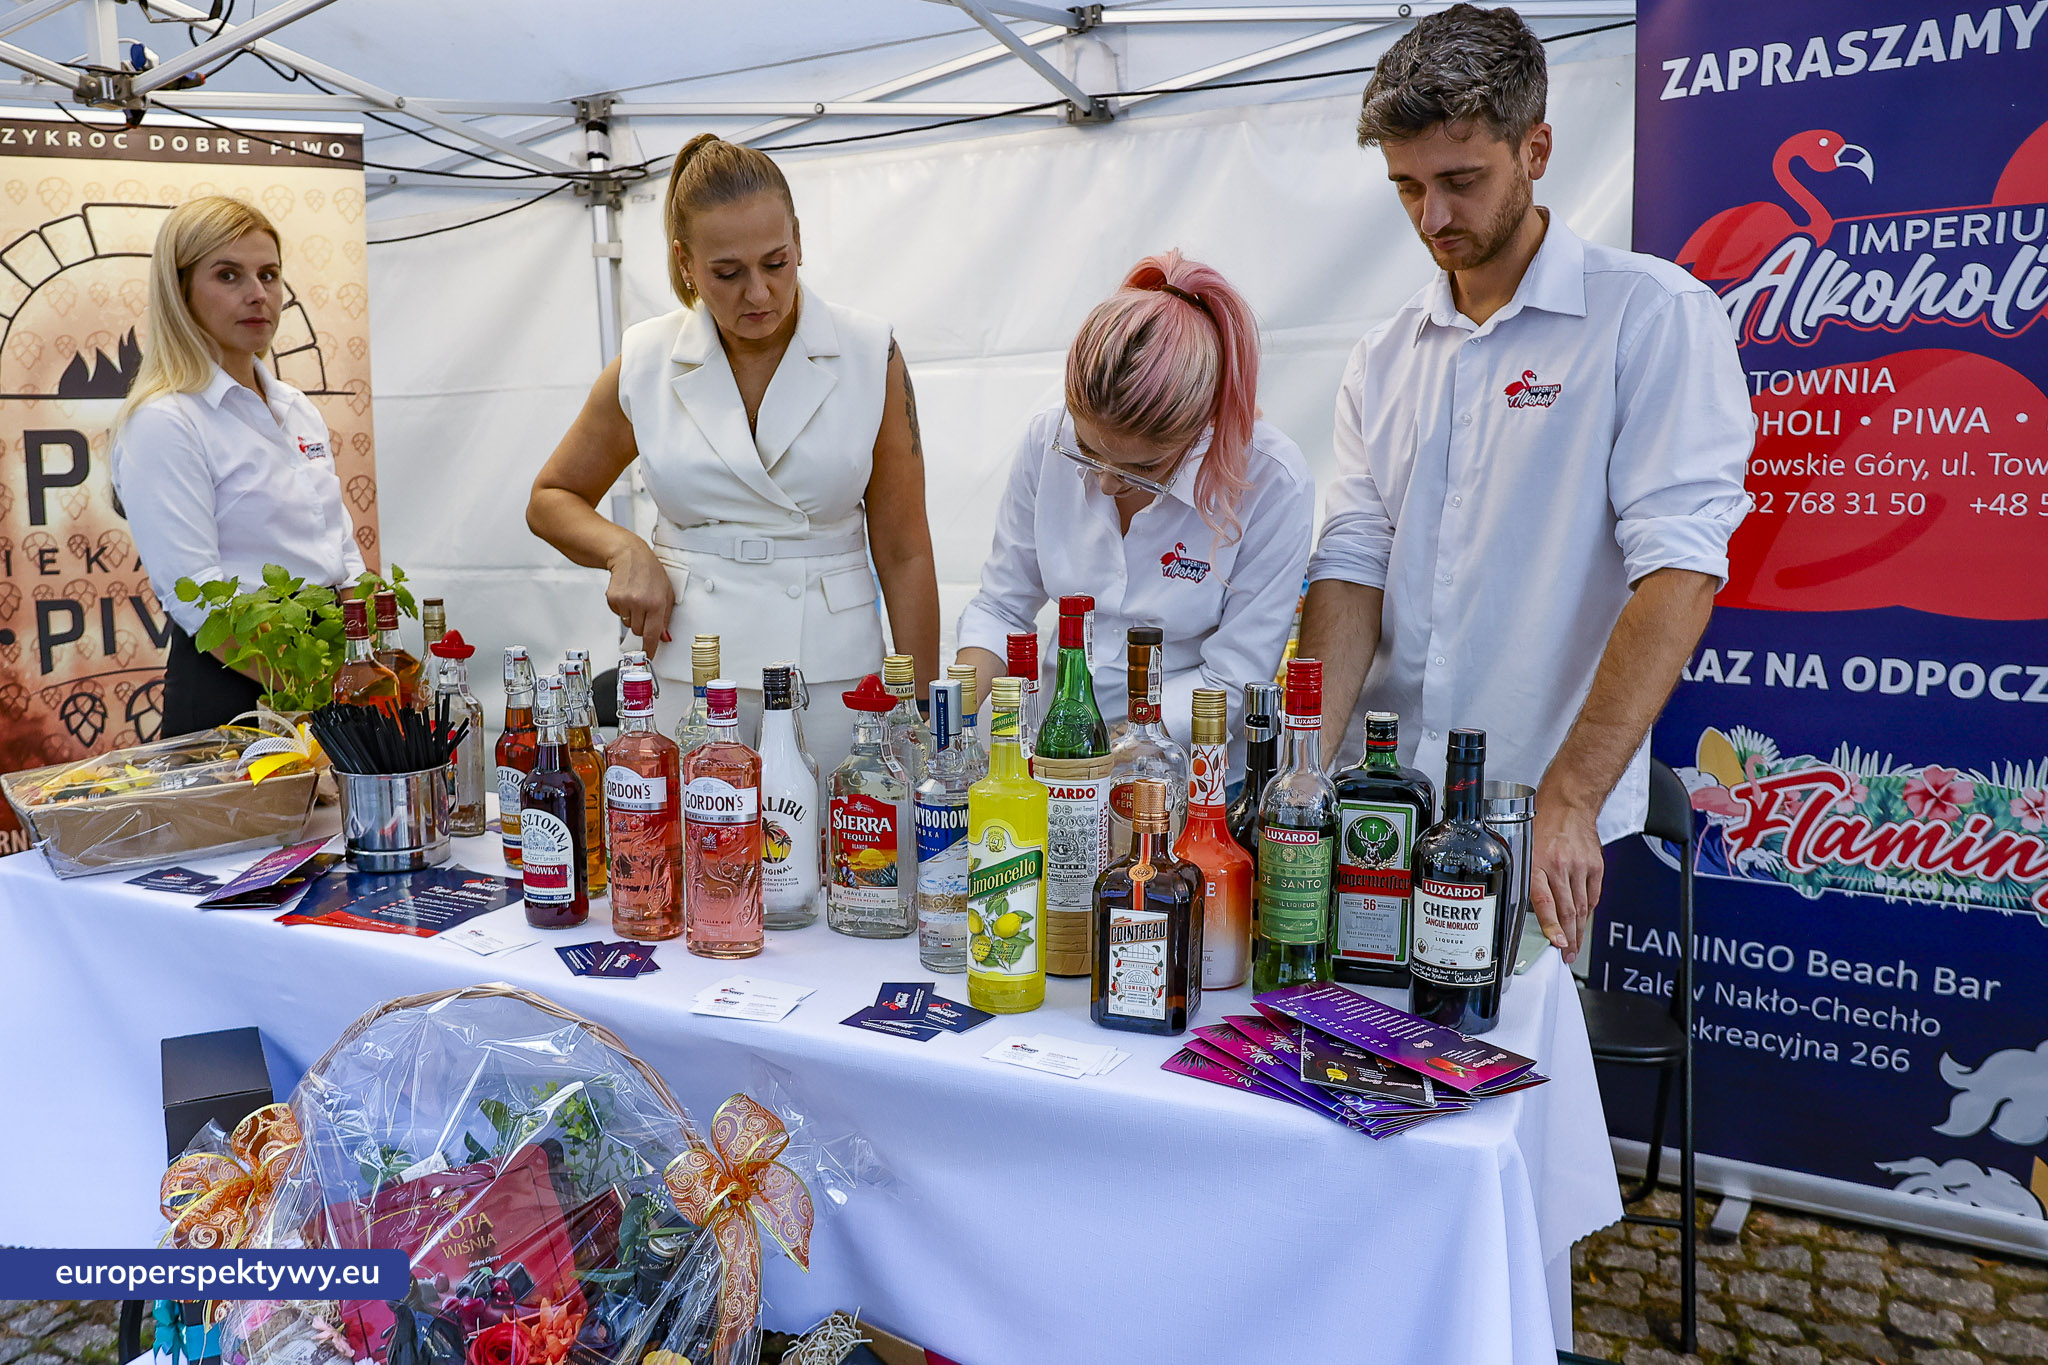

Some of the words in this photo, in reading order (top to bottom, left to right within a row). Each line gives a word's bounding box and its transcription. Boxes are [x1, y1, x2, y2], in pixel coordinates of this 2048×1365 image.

[1660, 1, 2048, 100] ZAPRASZAMY
[149, 135, 250, 154] DOBRE
[270, 139, 345, 158] PIWO
[1848, 208, 2048, 256] IMPERIU
[1752, 410, 1840, 436] HOLI
[1892, 406, 1991, 435] PIWA
[1854, 451, 1930, 482] Góry,
[1941, 451, 1976, 476] ul.
[1784, 492, 1836, 514] 768
[1844, 492, 1878, 515] 31
[1888, 492, 1926, 515] 50
[1970, 492, 2028, 516] +48
[1765, 652, 1829, 690] NA
[1842, 656, 2048, 703] ODPOCZ
[1136, 707, 1148, 716] PF
[1295, 717, 1320, 725] LUXARDO
[685, 790, 743, 812] GORDON'S
[833, 806, 893, 834] SIERRA
[842, 831, 880, 842] TEQUILA
[1267, 829, 1316, 843] LUXARDO
[968, 858, 1036, 898] Limoncello
[1280, 879, 1322, 889] SANTO
[1874, 875, 1938, 897] BEACH
[1942, 883, 1983, 900] BAR
[1425, 881, 1481, 899] LUXARDO
[1363, 898, 1376, 911] 56
[1423, 901, 1482, 921] CHERRY
[1111, 921, 1166, 943] COINTREAU
[1425, 916, 1445, 928] SANGUE
[1446, 922, 1479, 931] MORLACCO
[1435, 936, 1464, 945] LIQUEUR
[1608, 921, 1795, 972] FLAMINGO
[1807, 948, 1919, 992] Beach
[1934, 966, 2001, 1001] Bar
[1714, 981, 1942, 1038] Nakło-Chechło
[1850, 1041, 1911, 1073] 266
[441, 1232, 498, 1259] WIŚNIA
[485, 1254, 502, 1264] Cherry
